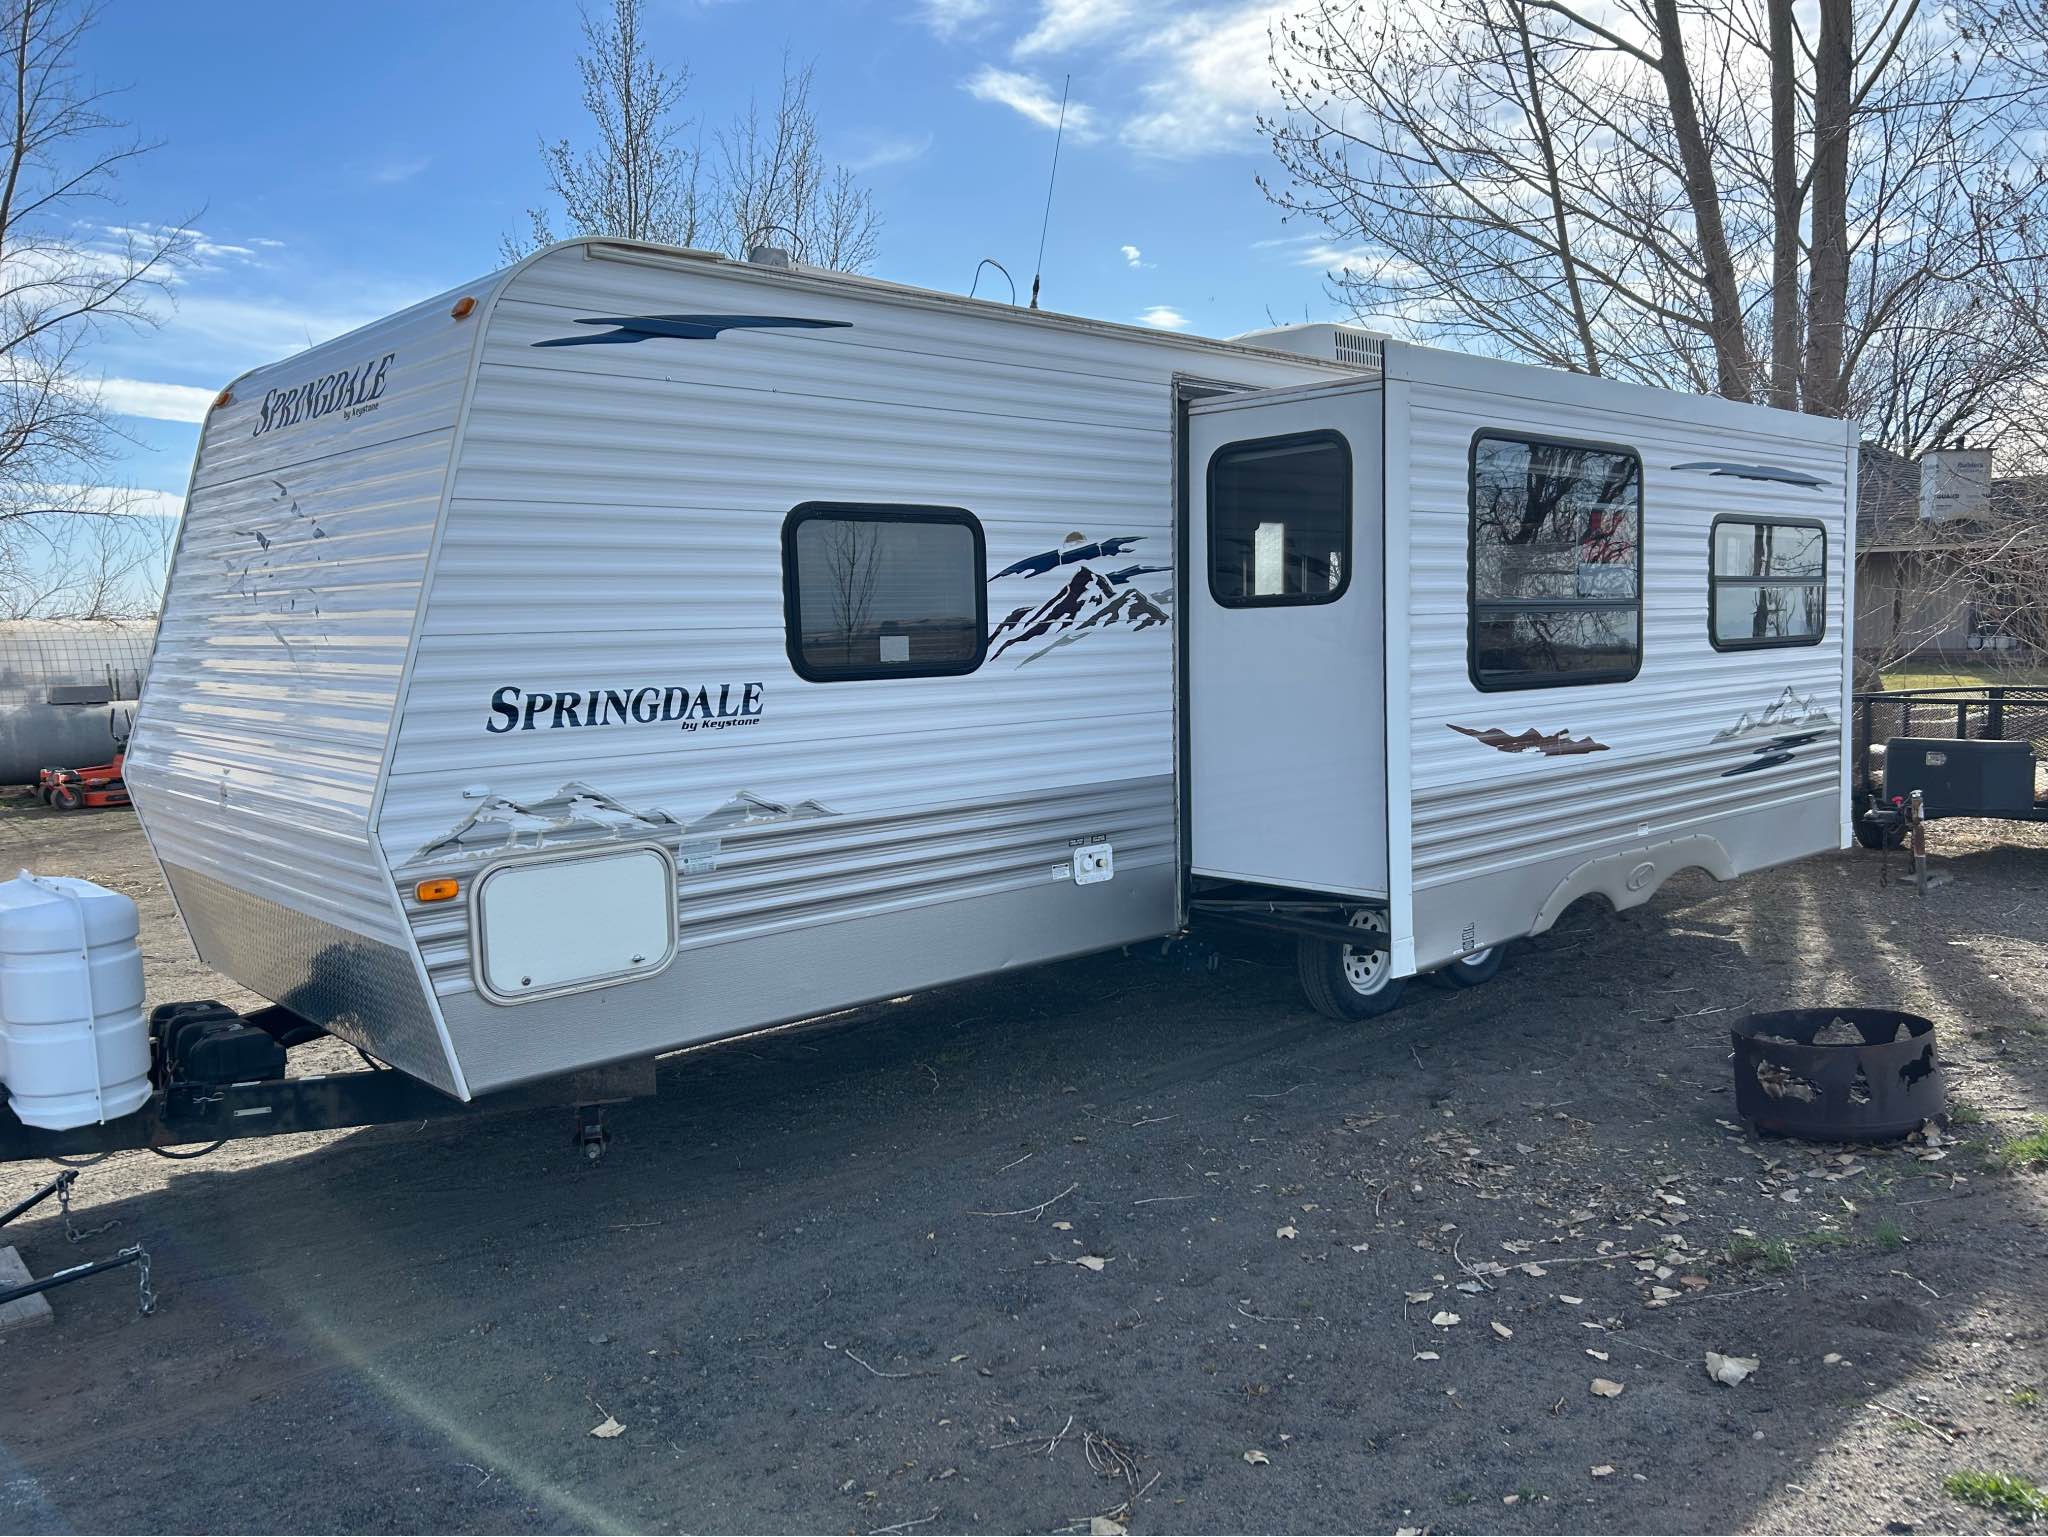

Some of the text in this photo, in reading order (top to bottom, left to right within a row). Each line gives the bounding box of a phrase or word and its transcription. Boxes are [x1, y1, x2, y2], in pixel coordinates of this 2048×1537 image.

[252, 353, 395, 437] SPRINGDALE
[343, 403, 379, 421] by Keystone
[485, 681, 764, 734] SPRINGDALE
[681, 717, 760, 732] by Keystone
